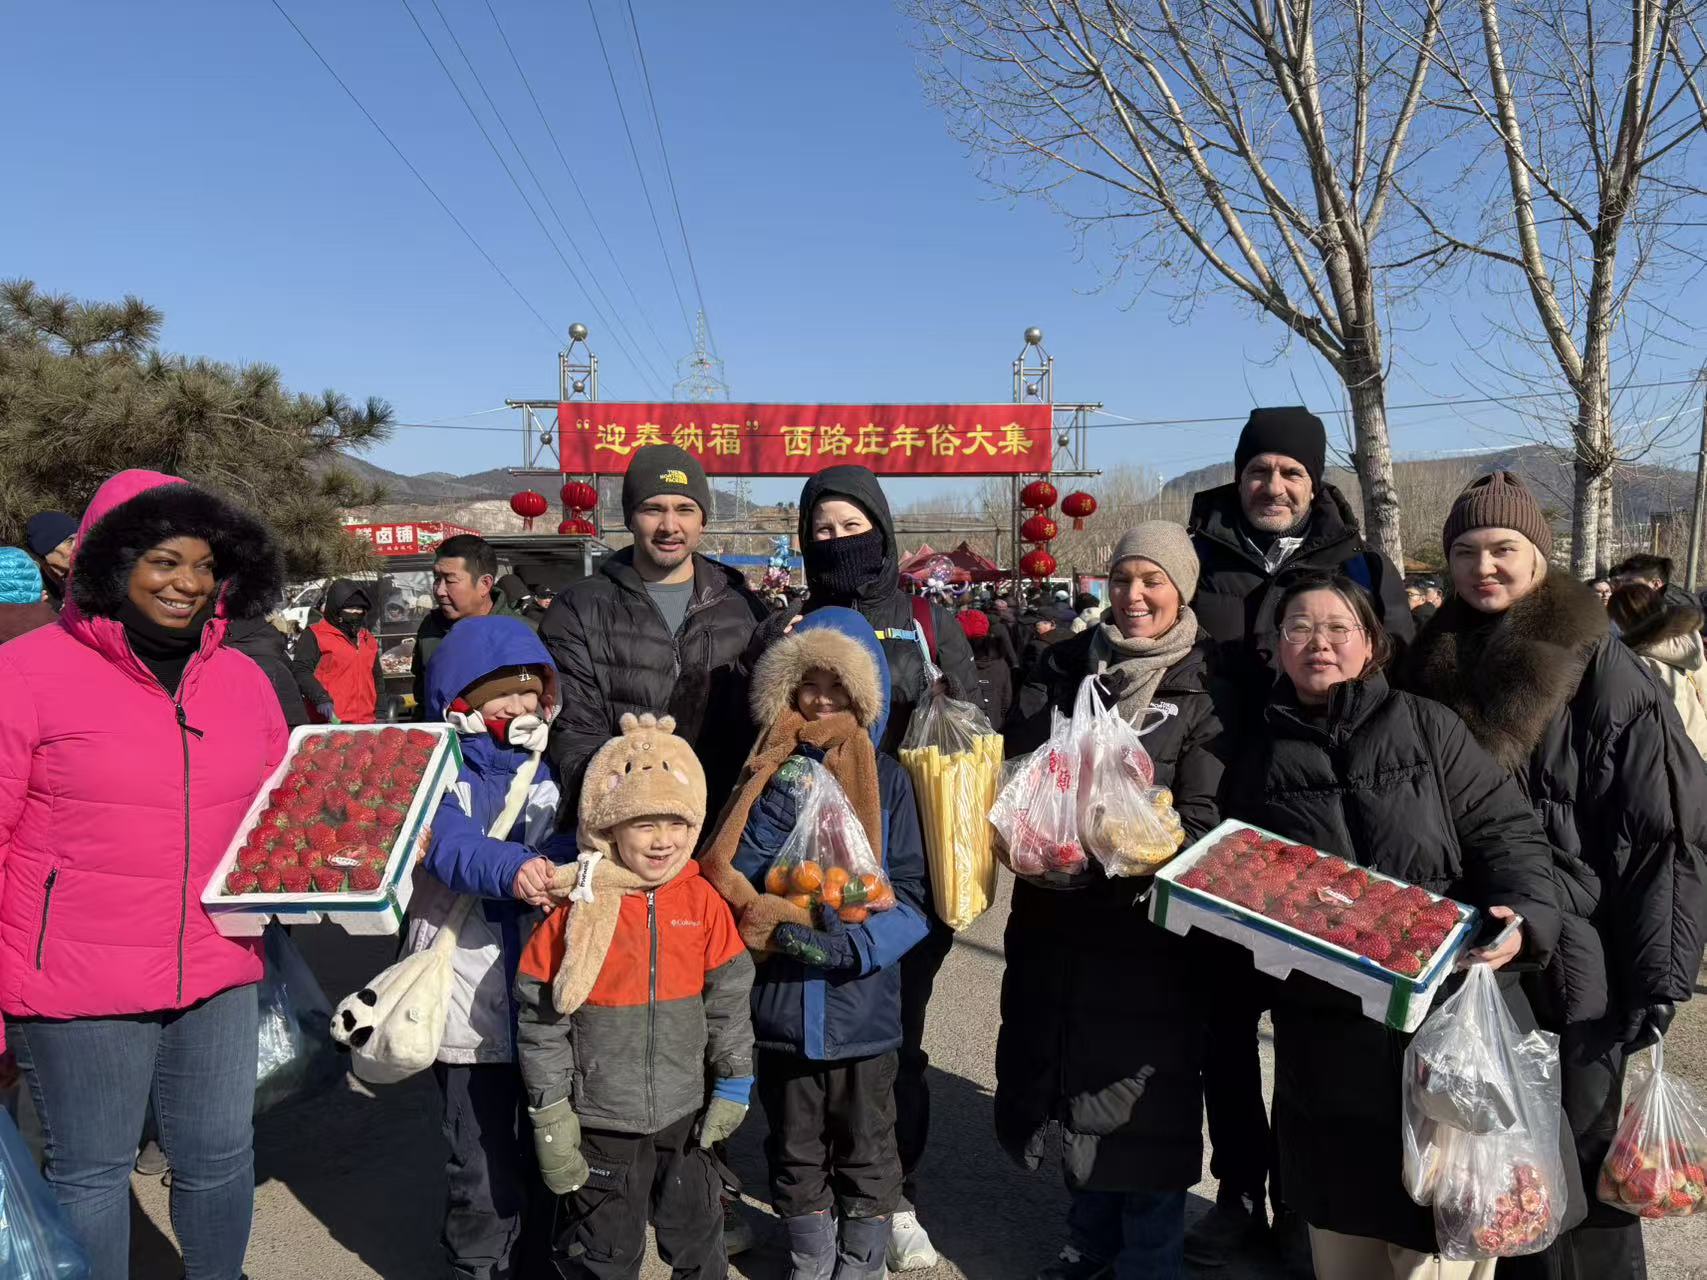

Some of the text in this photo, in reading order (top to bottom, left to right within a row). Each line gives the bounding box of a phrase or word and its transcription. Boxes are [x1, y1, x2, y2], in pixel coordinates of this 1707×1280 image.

[779, 421, 1034, 457] 西路庄年俗大集
